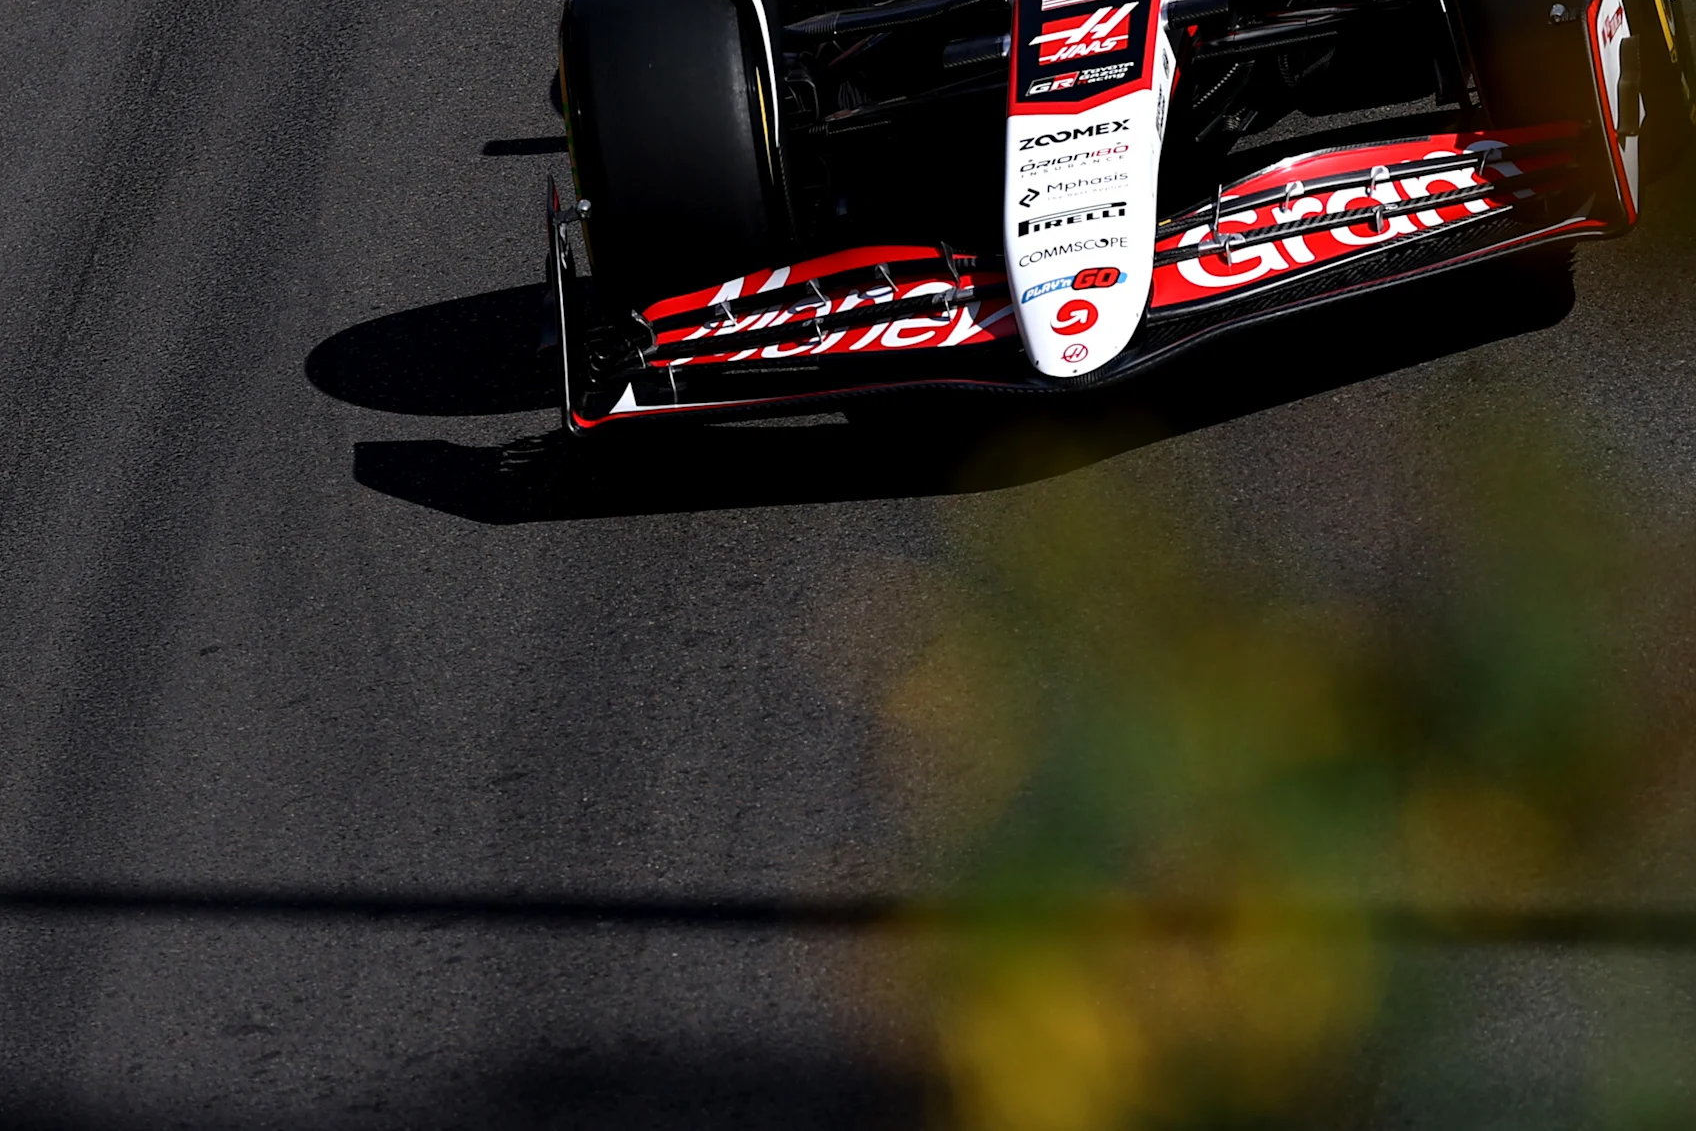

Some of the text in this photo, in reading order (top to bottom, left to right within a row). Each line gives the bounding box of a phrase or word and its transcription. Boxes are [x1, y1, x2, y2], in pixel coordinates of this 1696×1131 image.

[1038, 36, 1129, 63] HAAS
[1028, 76, 1077, 95] GR
[1019, 119, 1131, 151] ZOOMEX
[1021, 155, 1125, 179] INSURANCE
[1047, 172, 1129, 193] Mphasis
[1018, 201, 1127, 237] PIRELLI
[1019, 236, 1129, 268] COMMSCOPE
[1073, 267, 1120, 290] GO
